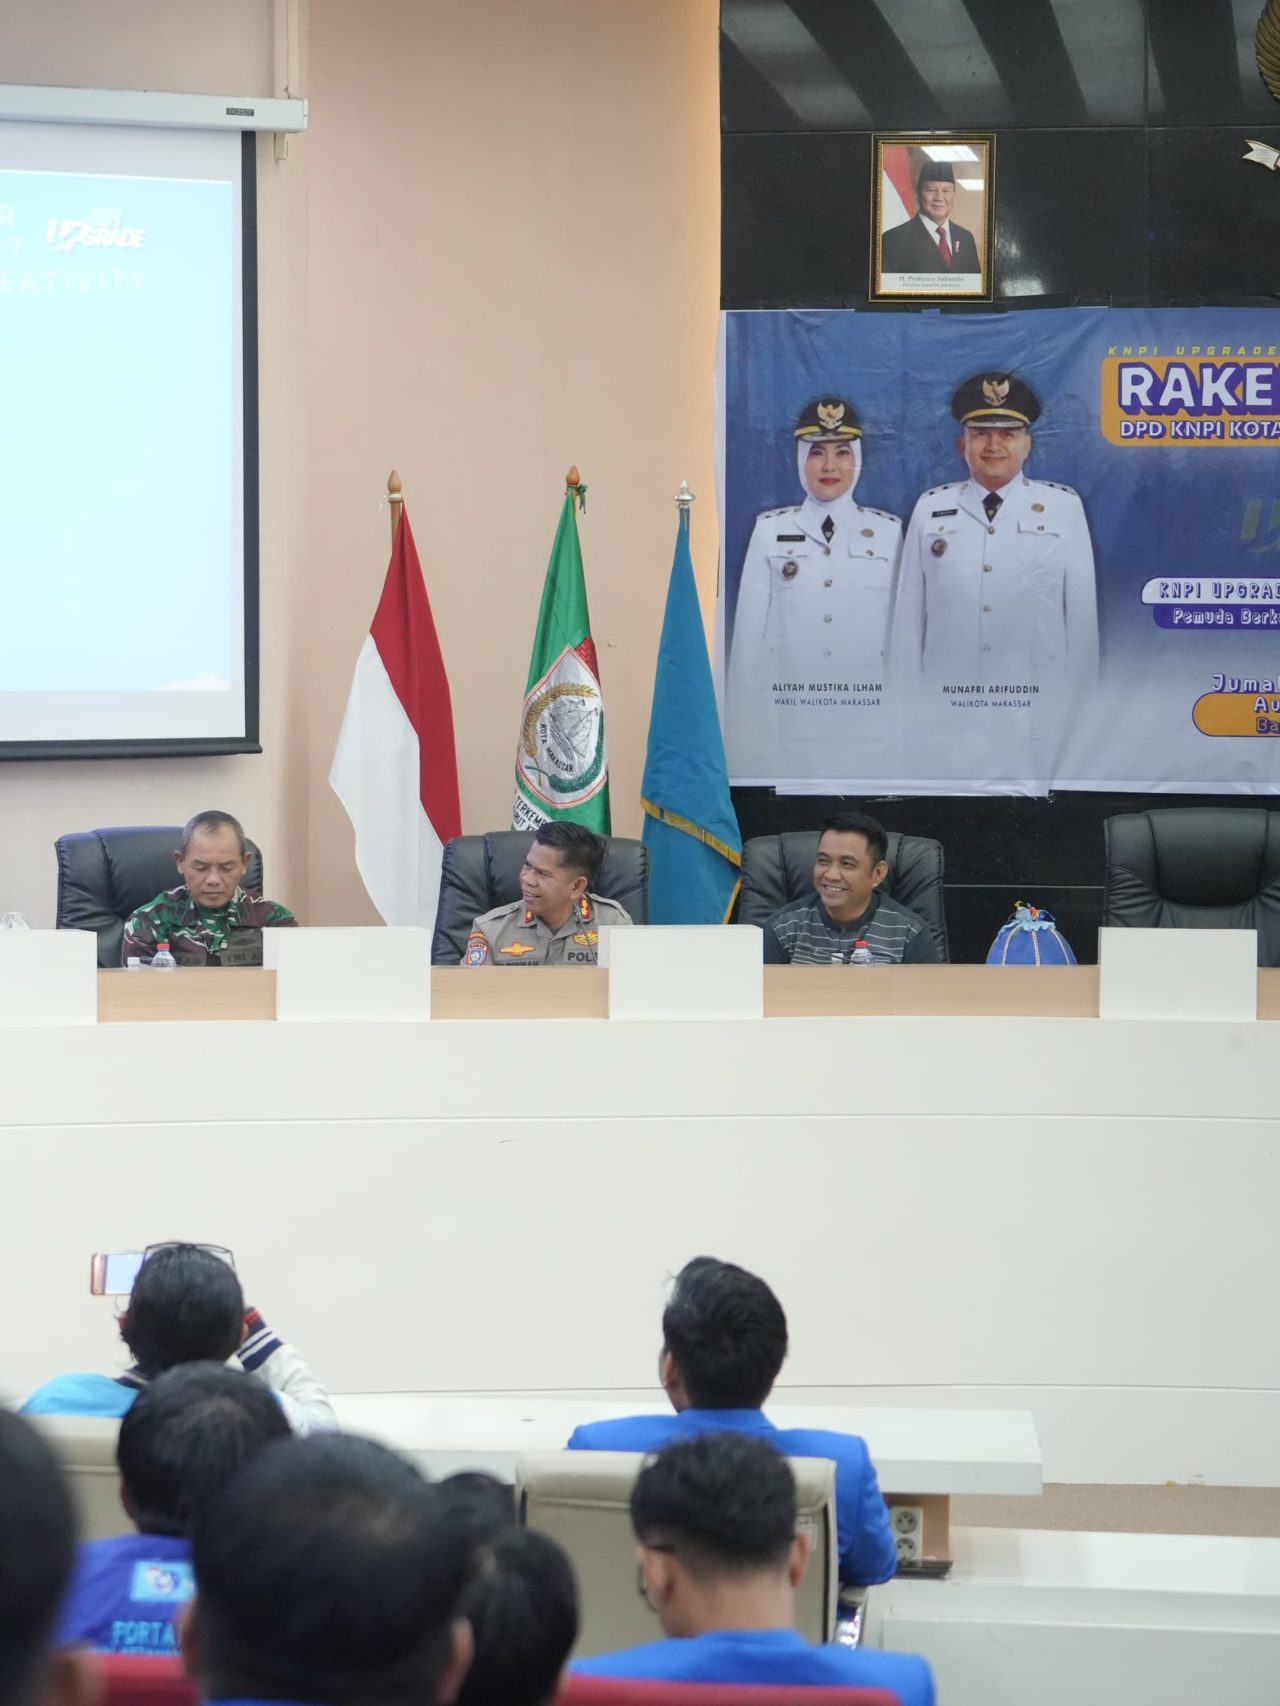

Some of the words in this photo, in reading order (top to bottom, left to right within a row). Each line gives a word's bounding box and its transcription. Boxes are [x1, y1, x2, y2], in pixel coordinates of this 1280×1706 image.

[1108, 346, 1158, 356] KNPI
[1176, 346, 1277, 356] UPGRADE
[1119, 364, 1280, 413] RAKE
[1121, 421, 1165, 438] DPD
[1171, 421, 1223, 438] KNPI
[1160, 582, 1201, 599] KNPI
[1173, 607, 1234, 625] Pemuda
[772, 683, 805, 693] ALIYAH
[808, 683, 850, 693] MUSTIKA
[852, 683, 883, 693] ILHAM
[942, 685, 985, 695] MUNAFRI
[988, 685, 1040, 695] ARIFUDDIN
[1212, 674, 1280, 692] Juma
[774, 698, 798, 706] WAKIL
[799, 698, 838, 706] WALIKOTA
[840, 698, 881, 706] MAKASSAR
[951, 700, 989, 708] WALIKOTA
[991, 700, 1032, 708] MAKASSAR
[545, 746, 574, 773] MAKASSAR
